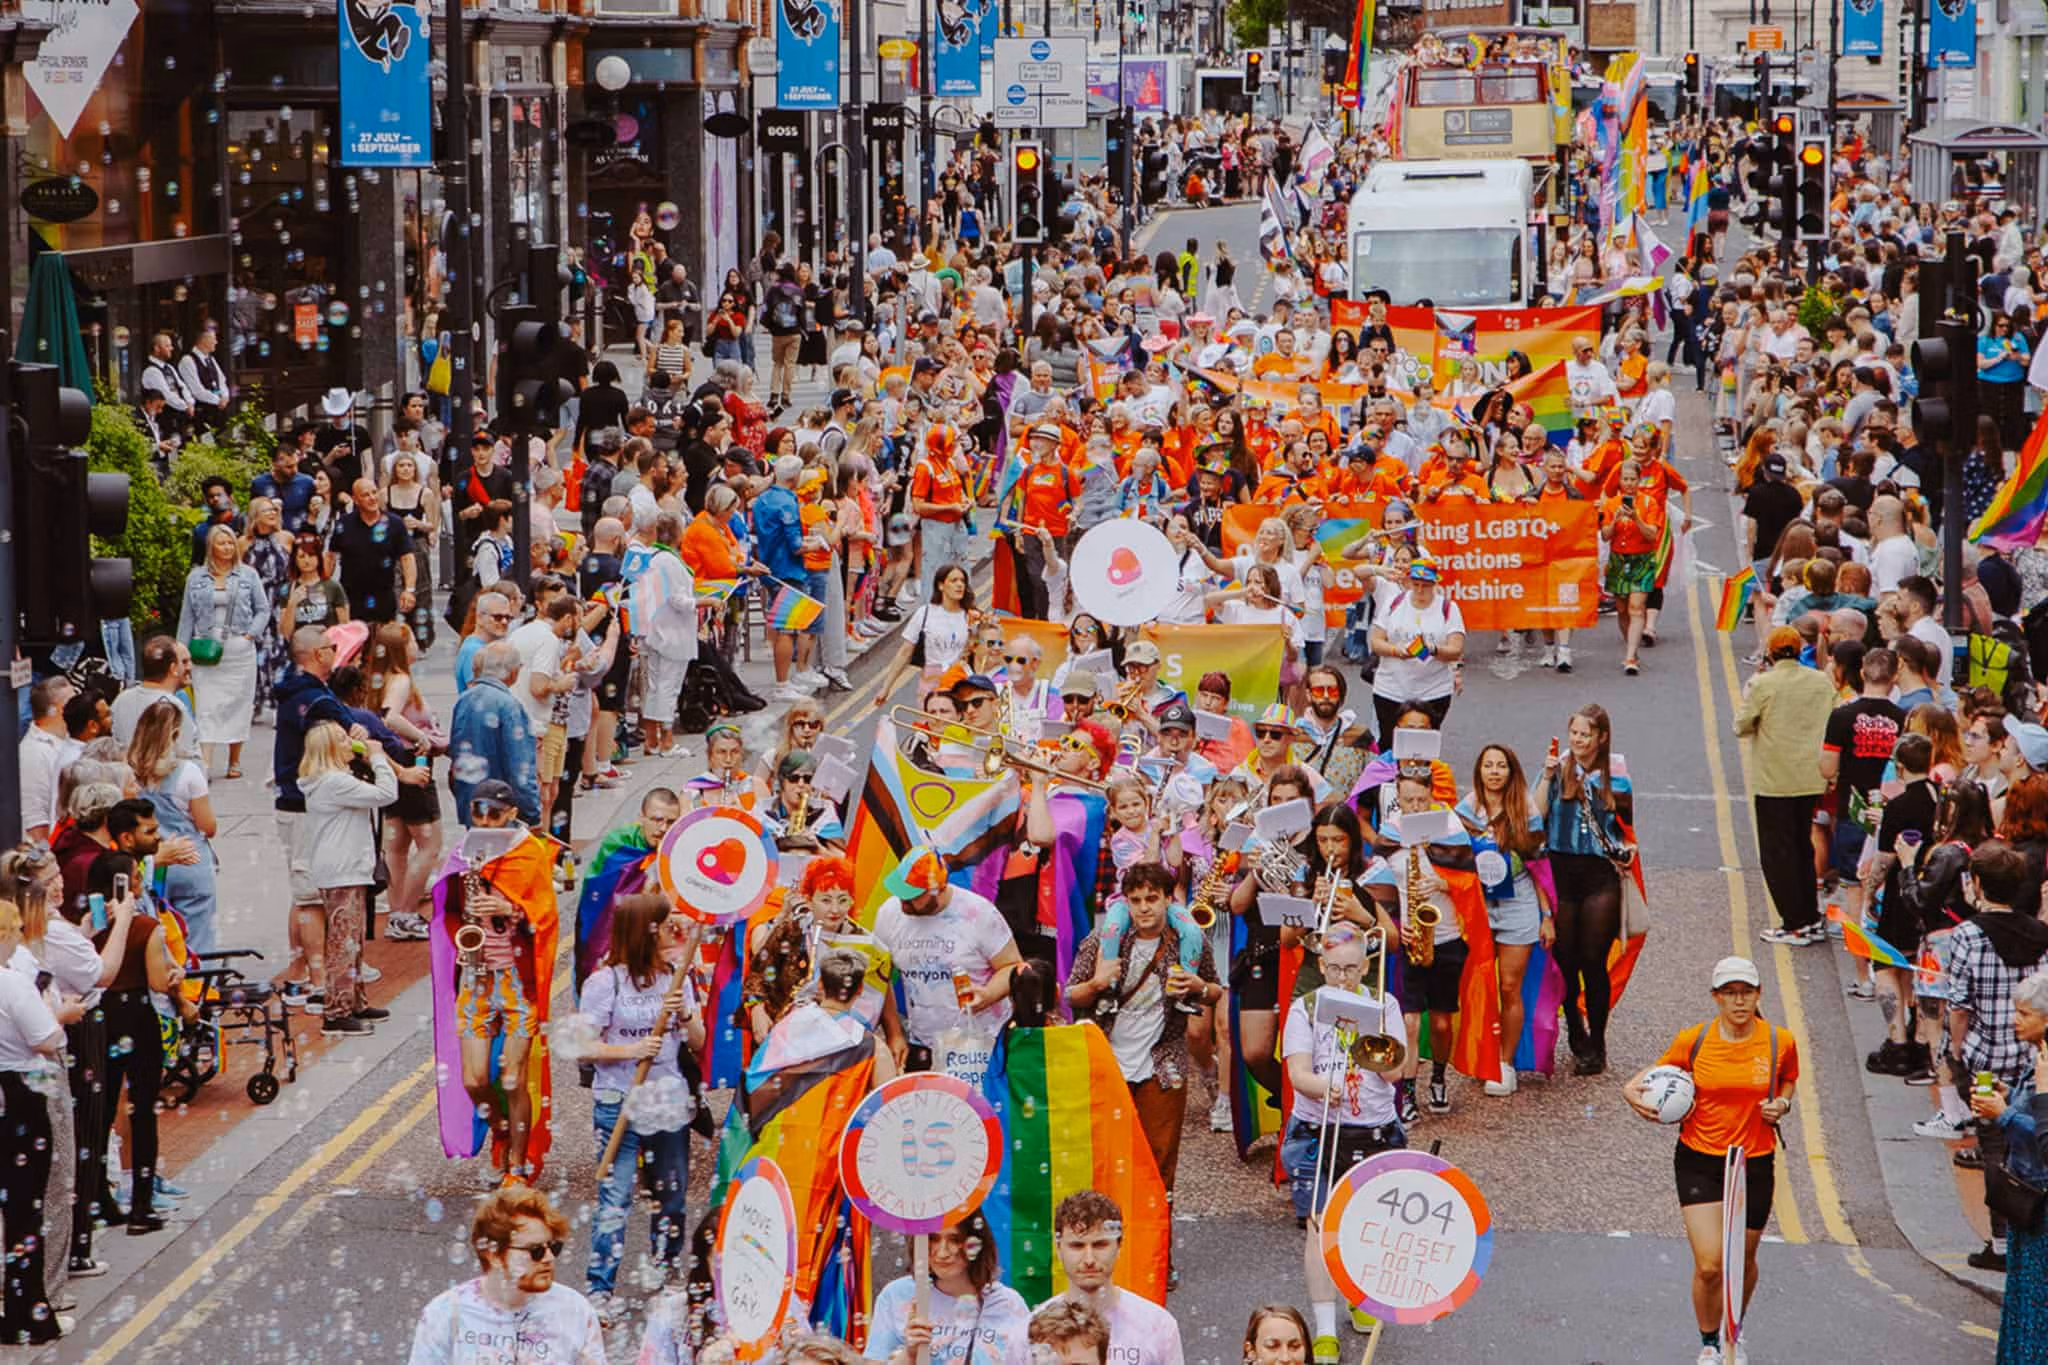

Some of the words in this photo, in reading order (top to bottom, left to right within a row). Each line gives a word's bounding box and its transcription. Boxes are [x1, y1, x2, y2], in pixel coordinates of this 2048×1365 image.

[360, 132, 371, 142] 27
[373, 132, 401, 142] JULY
[767, 126, 799, 137] BOSS
[357, 143, 421, 153] SEPTEMBER
[1419, 519, 1469, 545] iting
[1475, 517, 1561, 540] LGBTQ+
[1435, 548, 1523, 571] erations
[1434, 579, 1525, 601] orkshire
[897, 935, 955, 955] Learning
[902, 970, 953, 985] veryon
[620, 1028, 654, 1038] ever
[946, 1050, 991, 1067] Reuse
[742, 1203, 773, 1235] MOVE
[1376, 1186, 1457, 1236] 404
[1359, 1221, 1457, 1265] CLOSET
[1359, 1263, 1440, 1305] FOUND
[930, 1323, 996, 1344] arning
